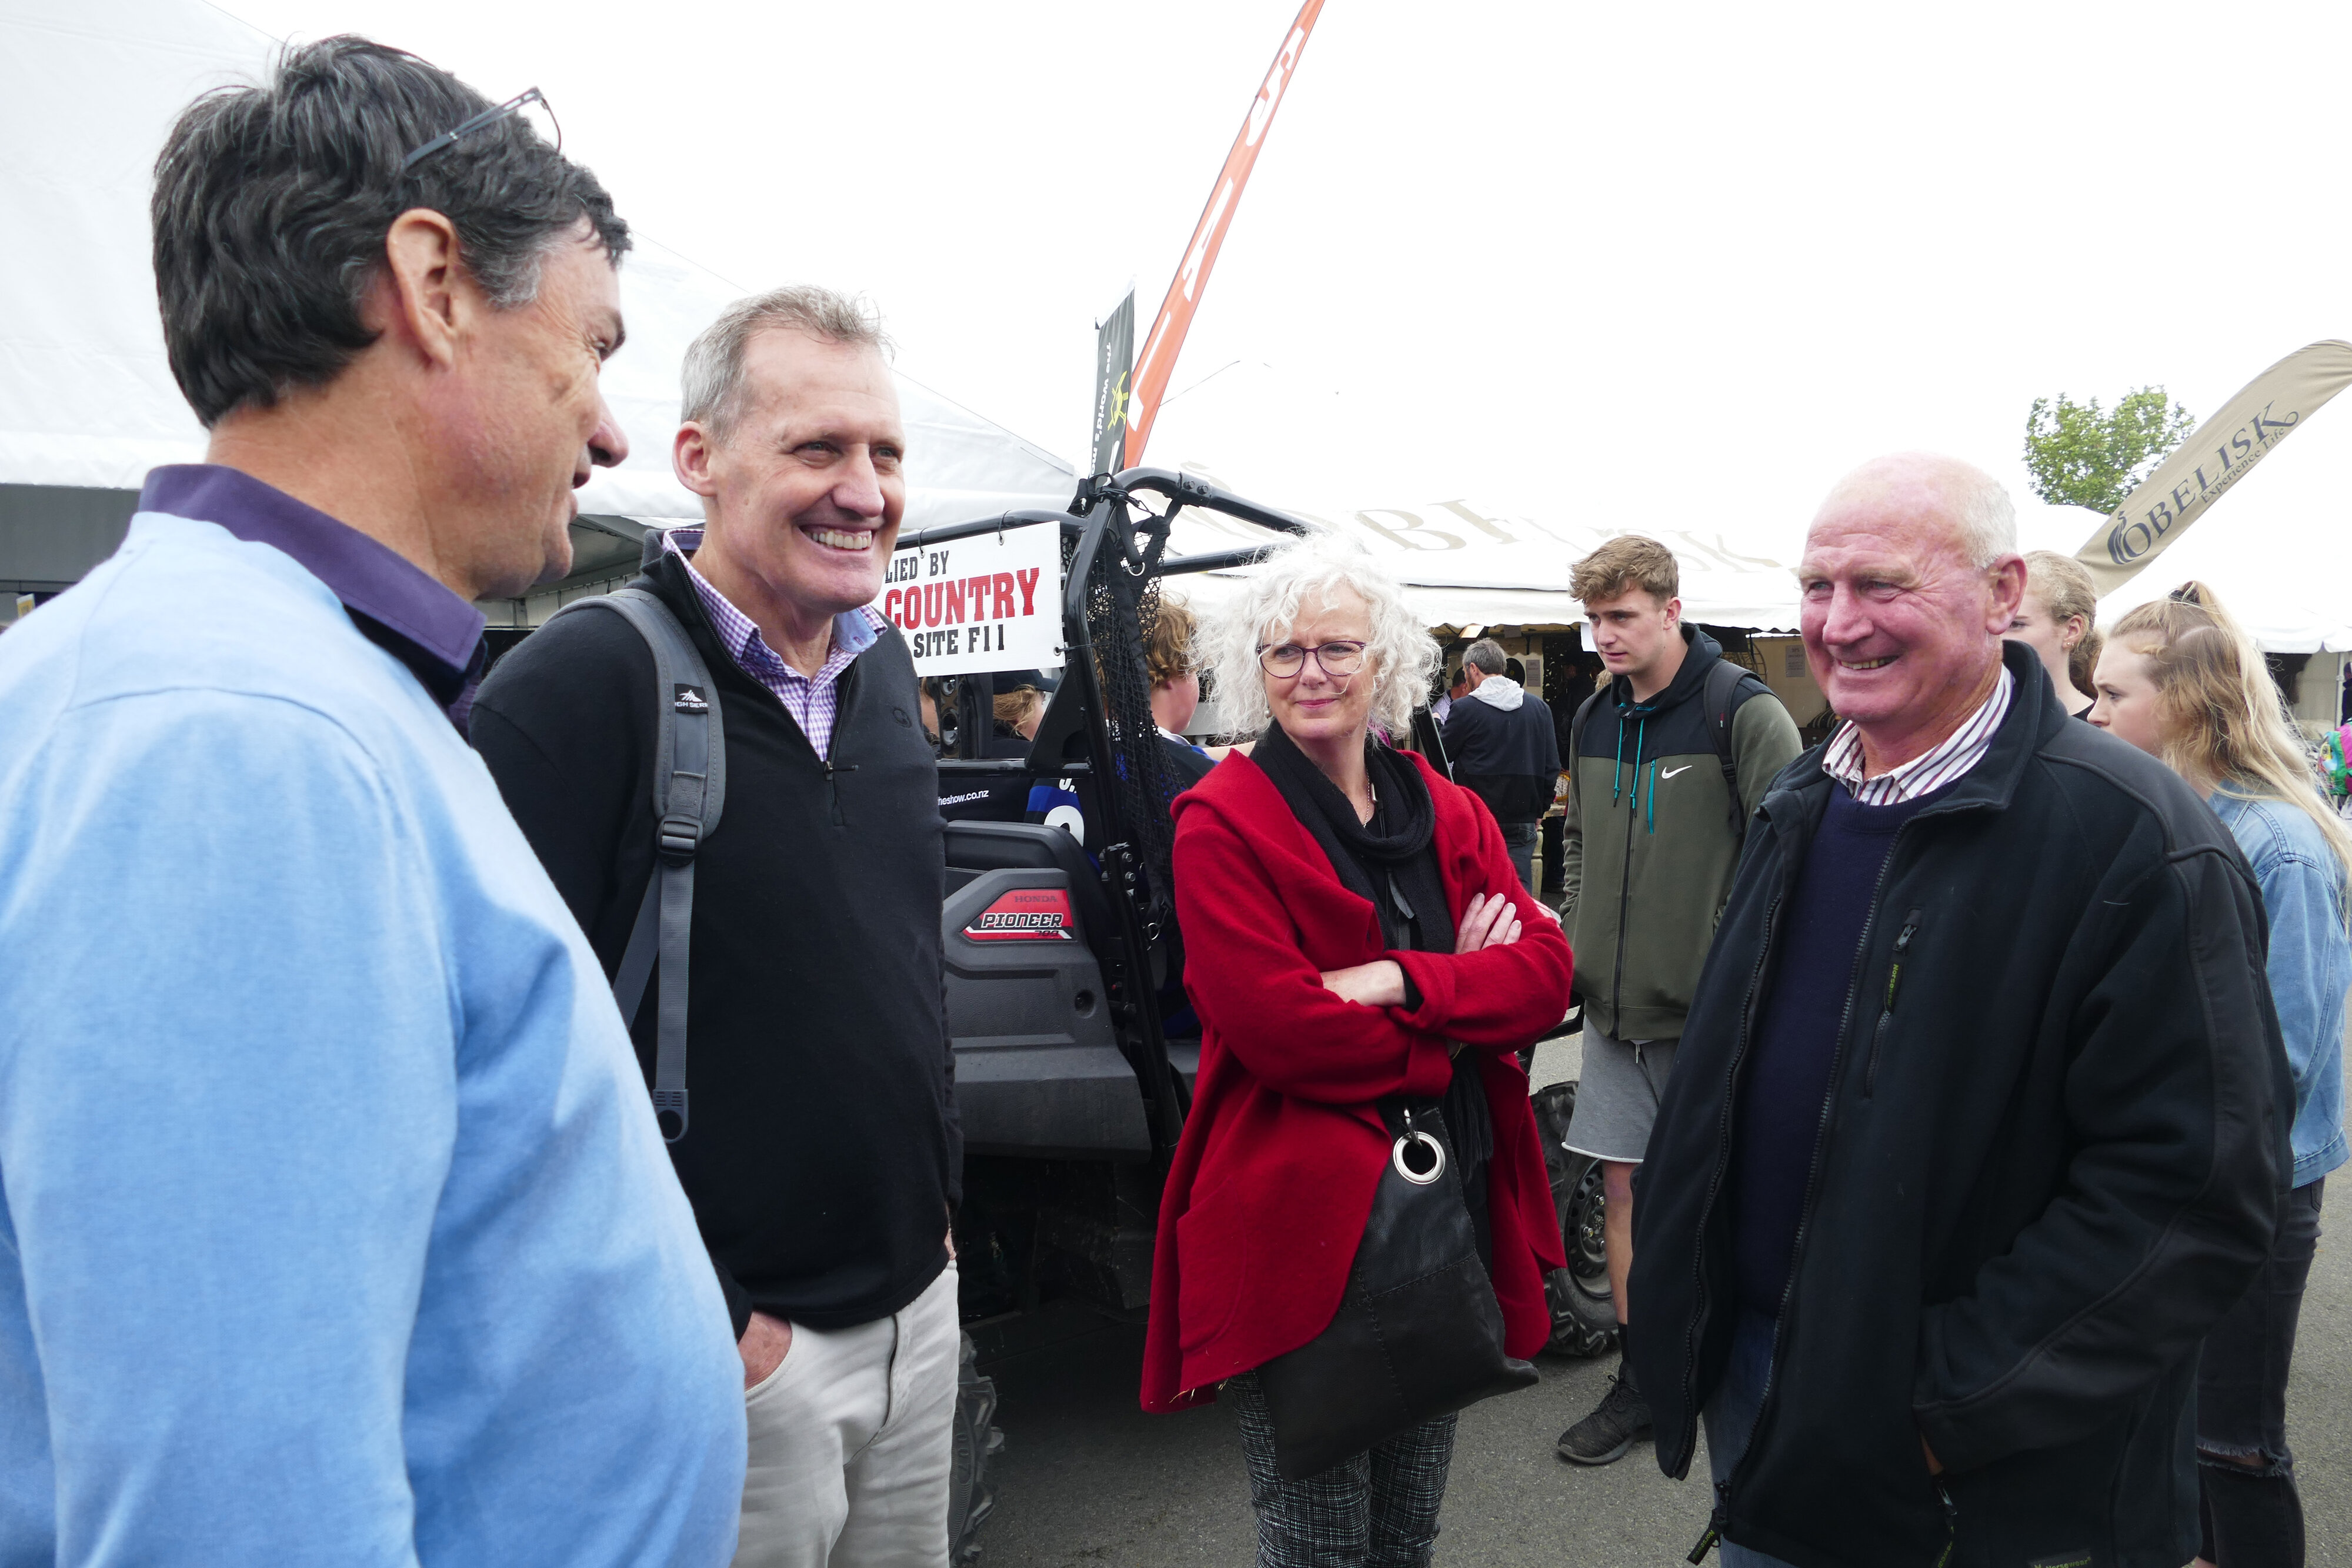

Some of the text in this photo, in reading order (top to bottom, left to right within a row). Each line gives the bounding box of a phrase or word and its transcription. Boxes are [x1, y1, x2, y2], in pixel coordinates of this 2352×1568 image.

[1095, 378, 1109, 442] world's
[2122, 400, 2300, 558] OBELISK
[2201, 428, 2286, 503] Experience Life
[929, 550, 949, 577] BY
[885, 568, 1040, 630] COUNTRY
[913, 629, 959, 658] SITE
[980, 912, 1063, 928] PIONEER
